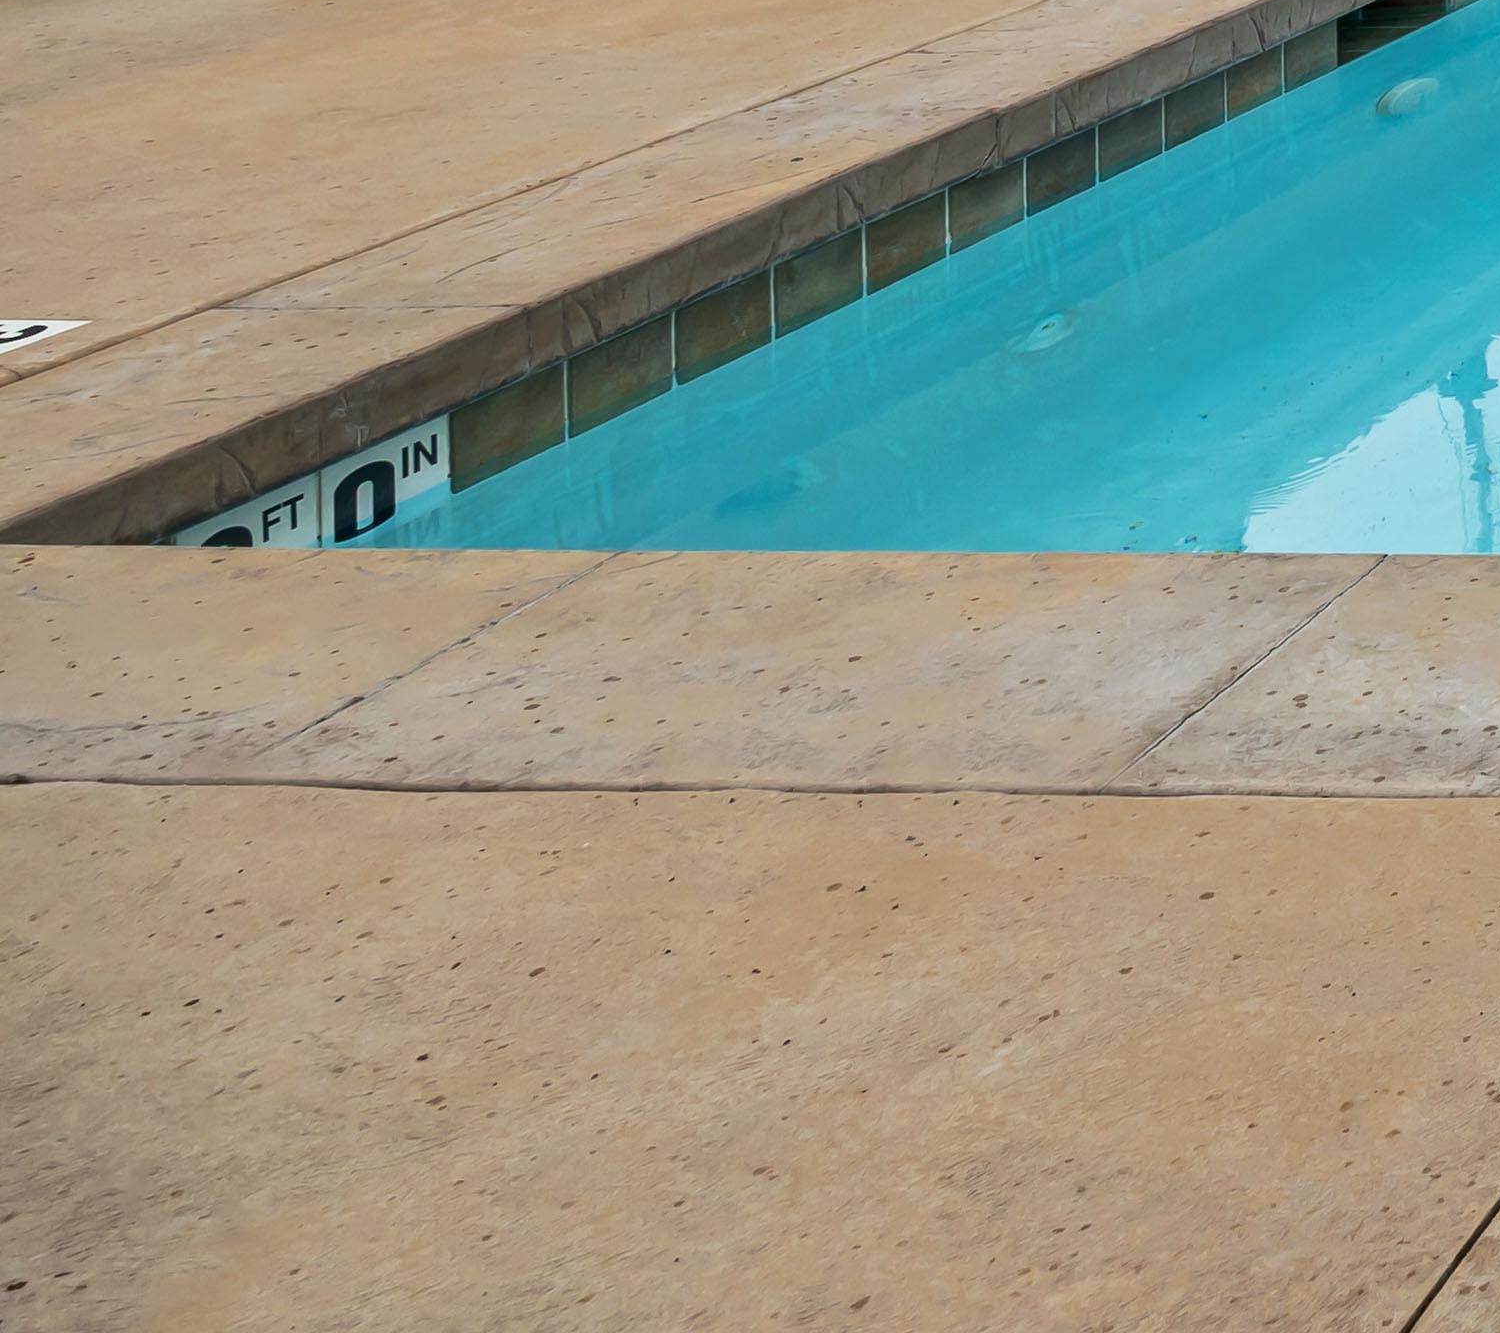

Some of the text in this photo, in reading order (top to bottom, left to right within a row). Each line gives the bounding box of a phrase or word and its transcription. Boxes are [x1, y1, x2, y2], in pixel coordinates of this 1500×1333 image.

[262, 493, 305, 544] FT
[333, 460, 396, 544] 0
[401, 433, 438, 480] IN
